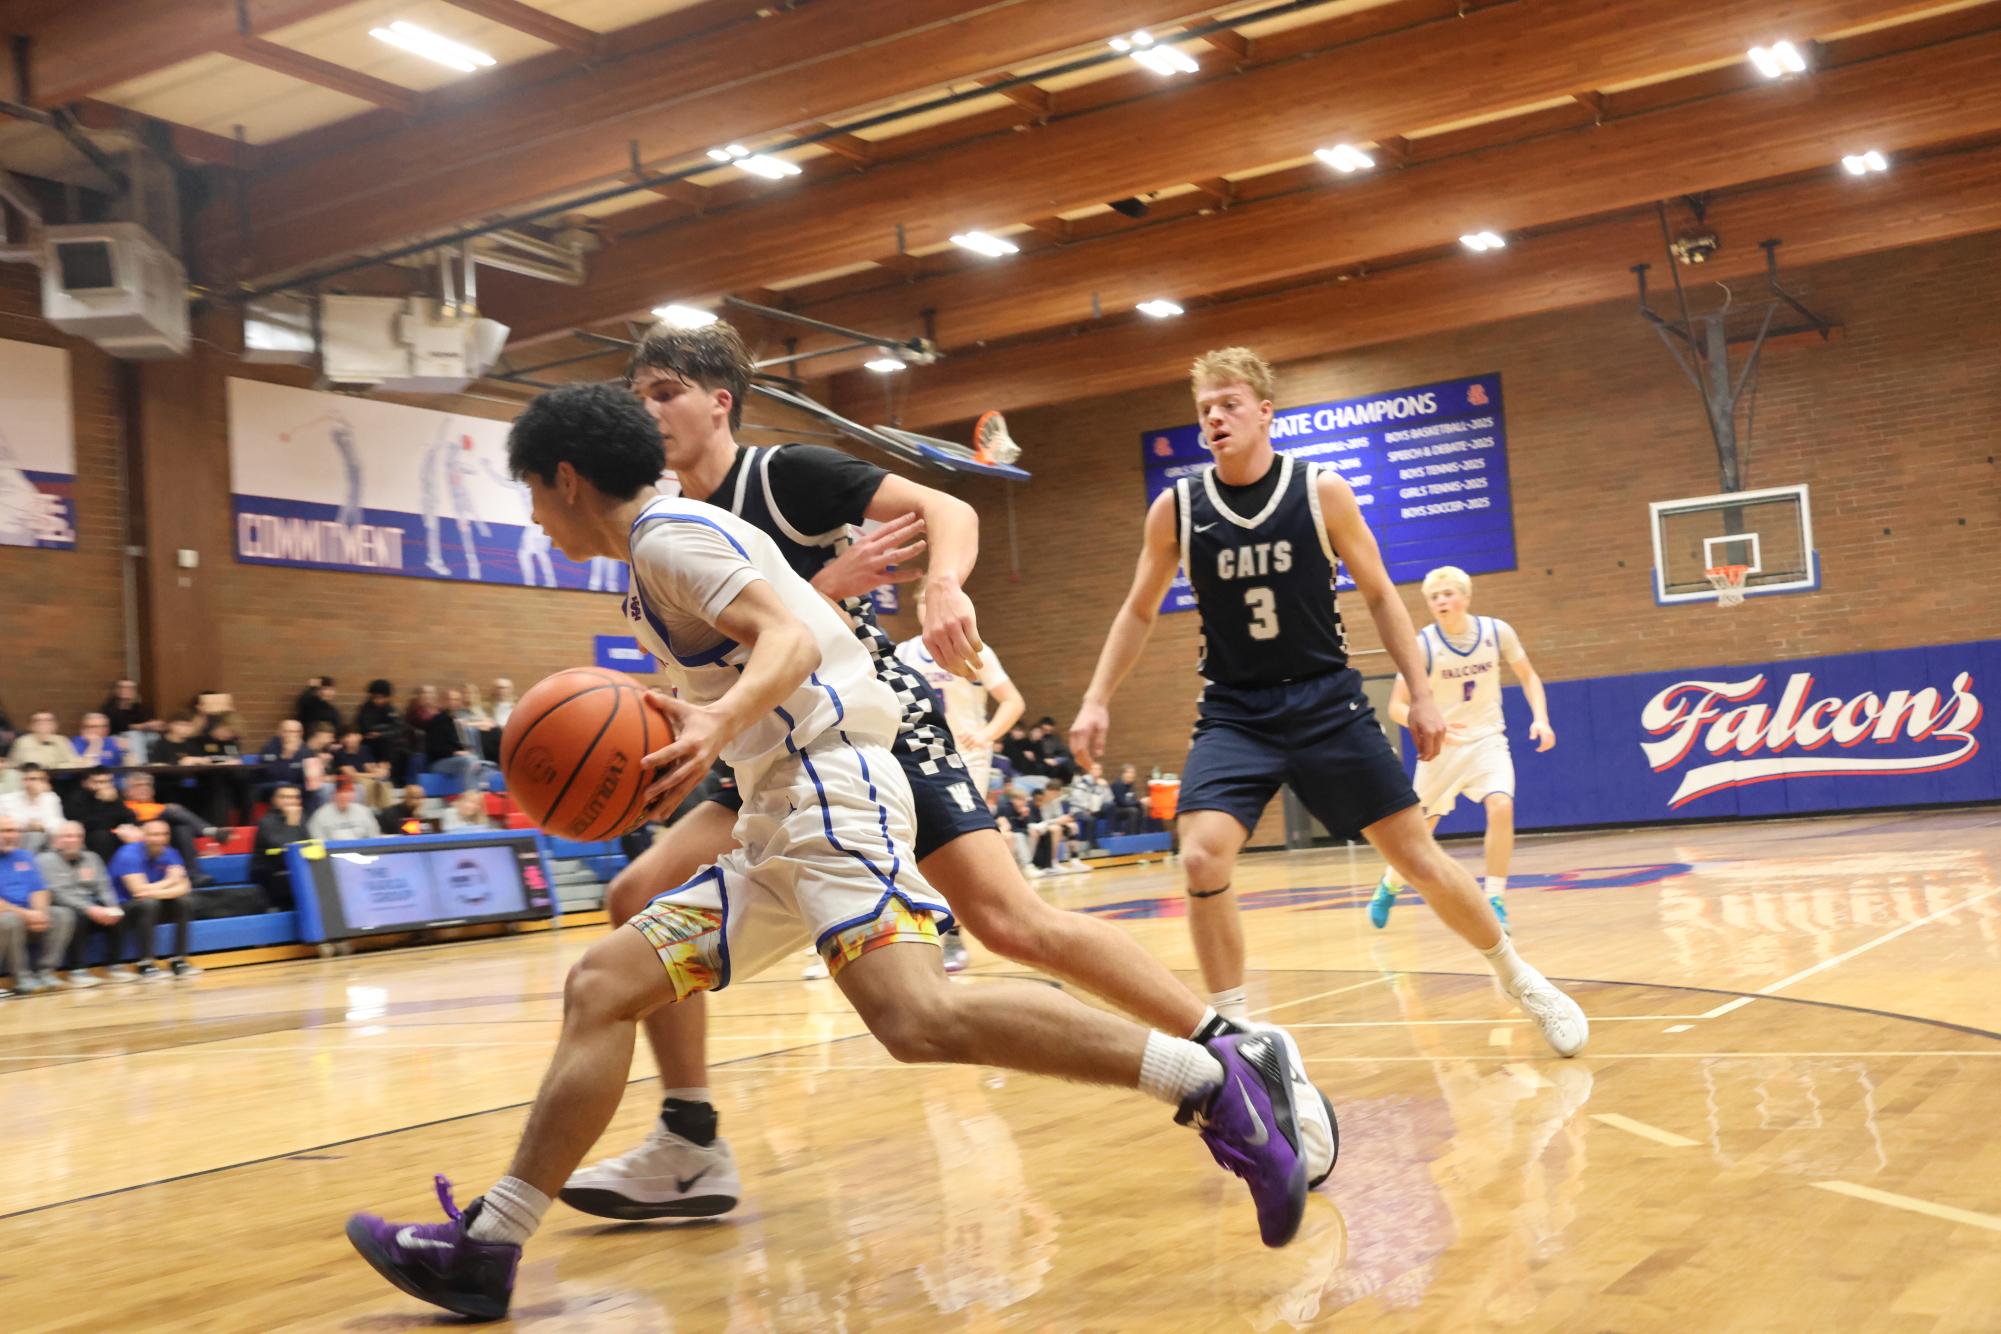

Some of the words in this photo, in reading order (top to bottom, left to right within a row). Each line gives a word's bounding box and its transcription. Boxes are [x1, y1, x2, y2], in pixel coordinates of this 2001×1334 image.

[1269, 413, 1313, 440] TATE
[1313, 392, 1438, 431] CHAMPIONS
[1385, 429, 1409, 443] BOYS
[1399, 467, 1425, 480] BOYS
[1399, 486, 1427, 499] GIRLS
[1400, 506, 1426, 519] BOYS
[238, 512, 405, 569] COMMITMENT
[1217, 540, 1292, 580] CATS
[1244, 586, 1281, 640] 3
[1640, 671, 1983, 774] Falcons
